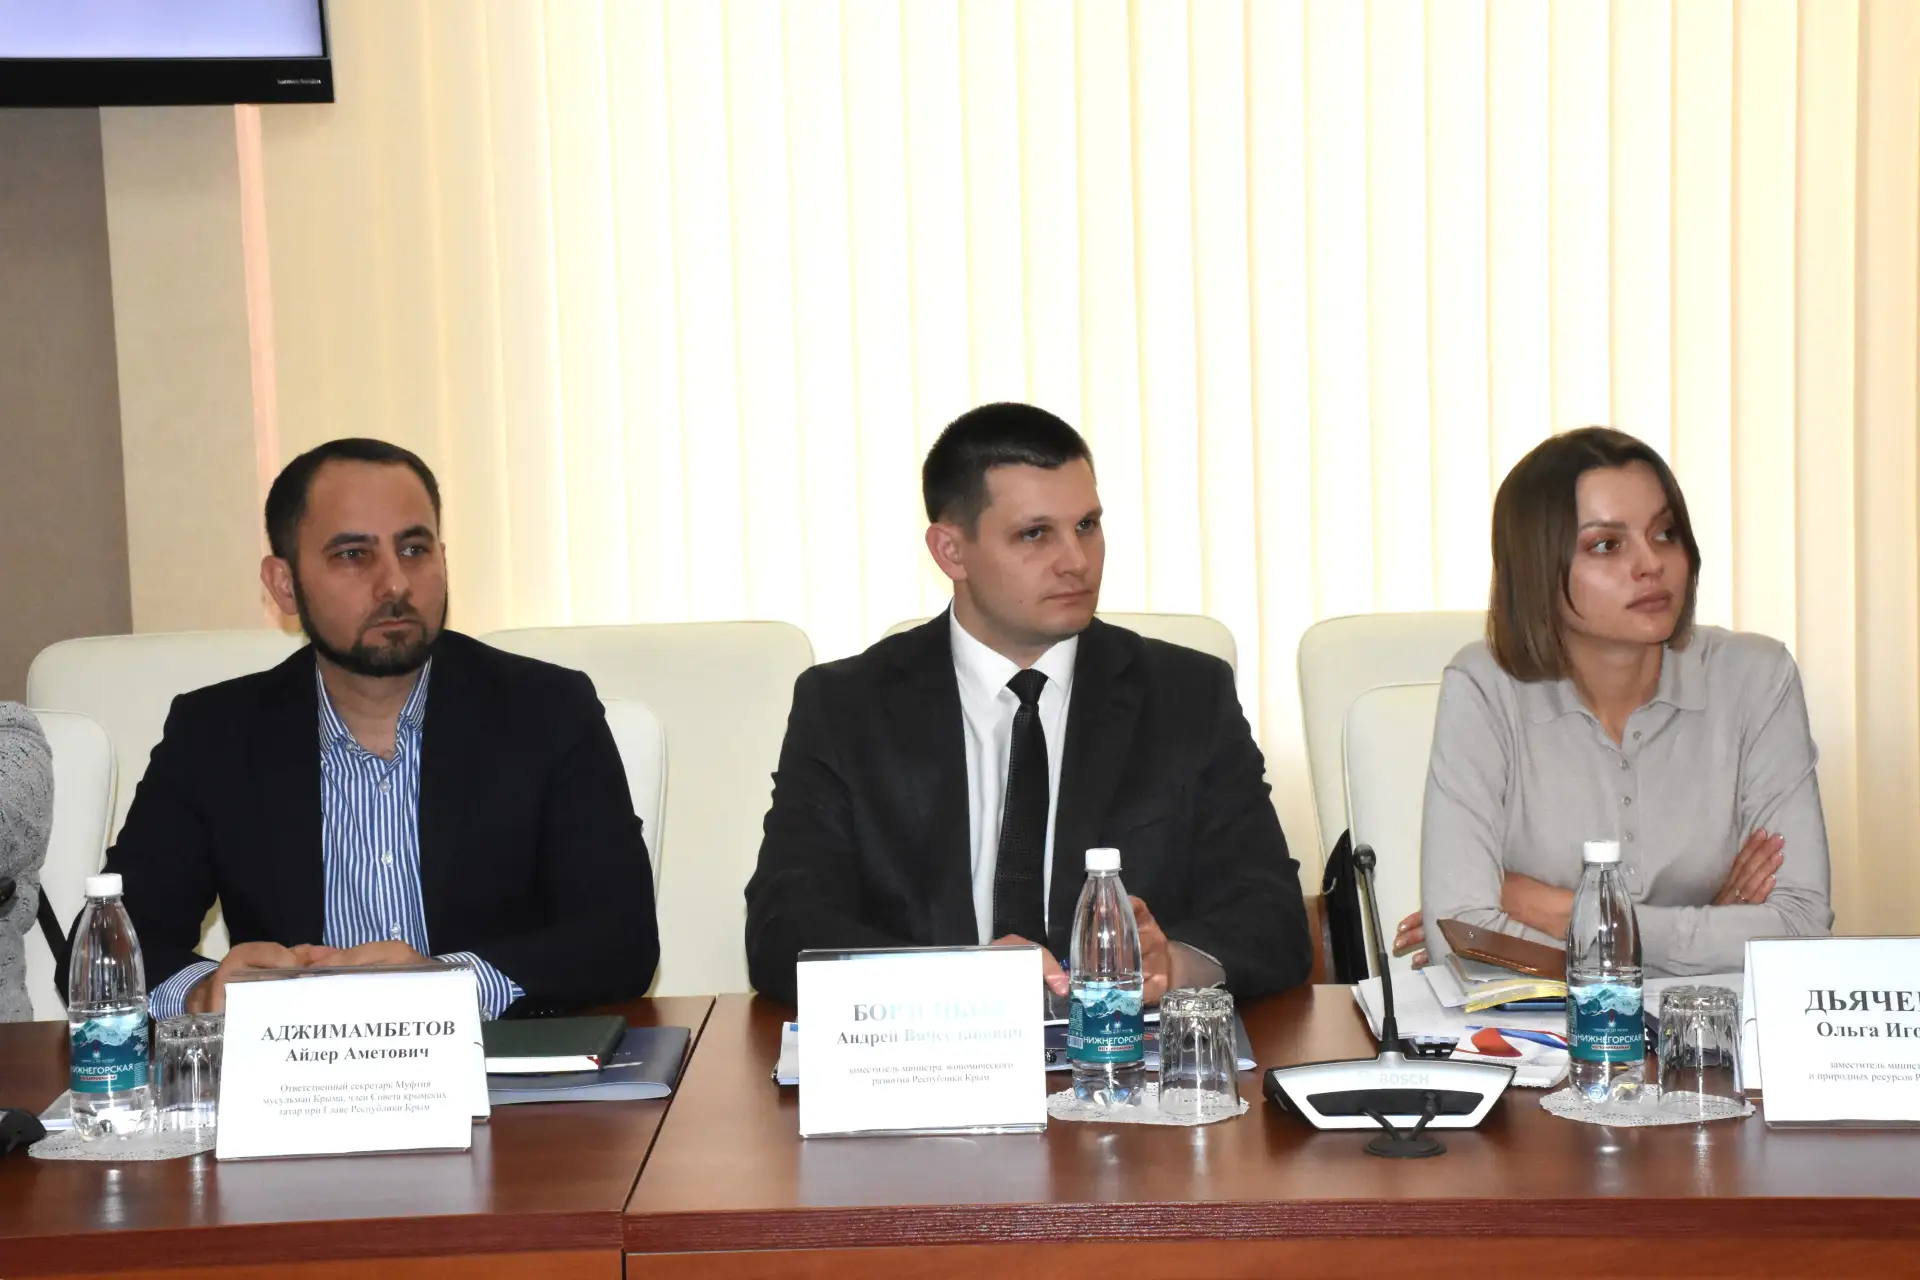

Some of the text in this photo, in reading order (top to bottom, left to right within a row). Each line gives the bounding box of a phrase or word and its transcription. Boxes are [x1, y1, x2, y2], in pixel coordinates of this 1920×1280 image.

[1805, 990, 1920, 1015] ДЬЯЧЕ
[261, 1021, 455, 1042] АДЖИМАМБЕТОВ
[1817, 1022, 1879, 1037] Ольга
[837, 1031, 898, 1047] Андрей
[286, 1048, 428, 1064] Айдер Аметович
[964, 1073, 990, 1083] Крым
[280, 1080, 431, 1093] Ответственный секретарь Муфтия
[262, 1096, 311, 1107] мусульман
[403, 1092, 447, 1102] крымских
[304, 1108, 321, 1116] при
[404, 1103, 430, 1112] Крым
